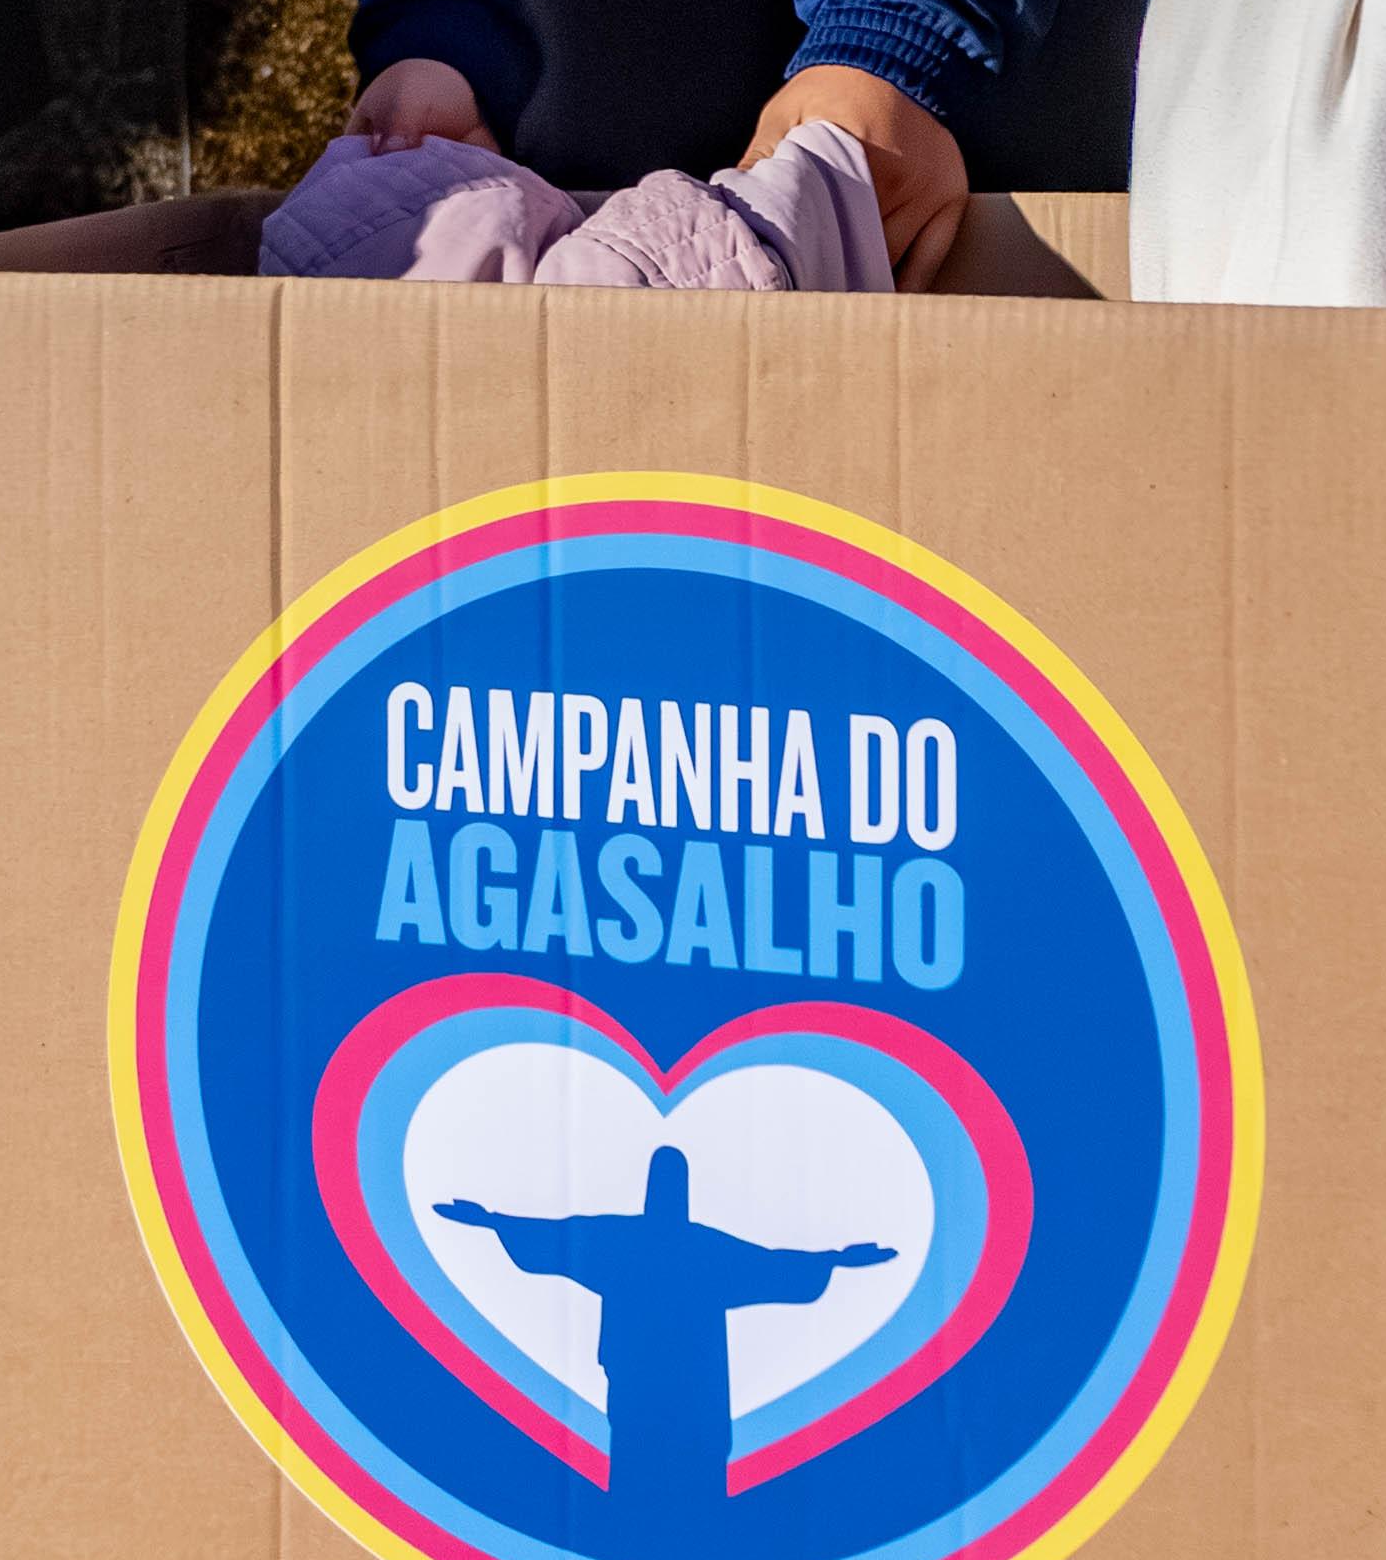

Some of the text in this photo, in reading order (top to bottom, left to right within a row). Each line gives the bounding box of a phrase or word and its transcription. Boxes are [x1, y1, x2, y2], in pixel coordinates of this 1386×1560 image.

[386, 681, 957, 851] CAMPANHA DO
[375, 818, 965, 990] AGASALHO
